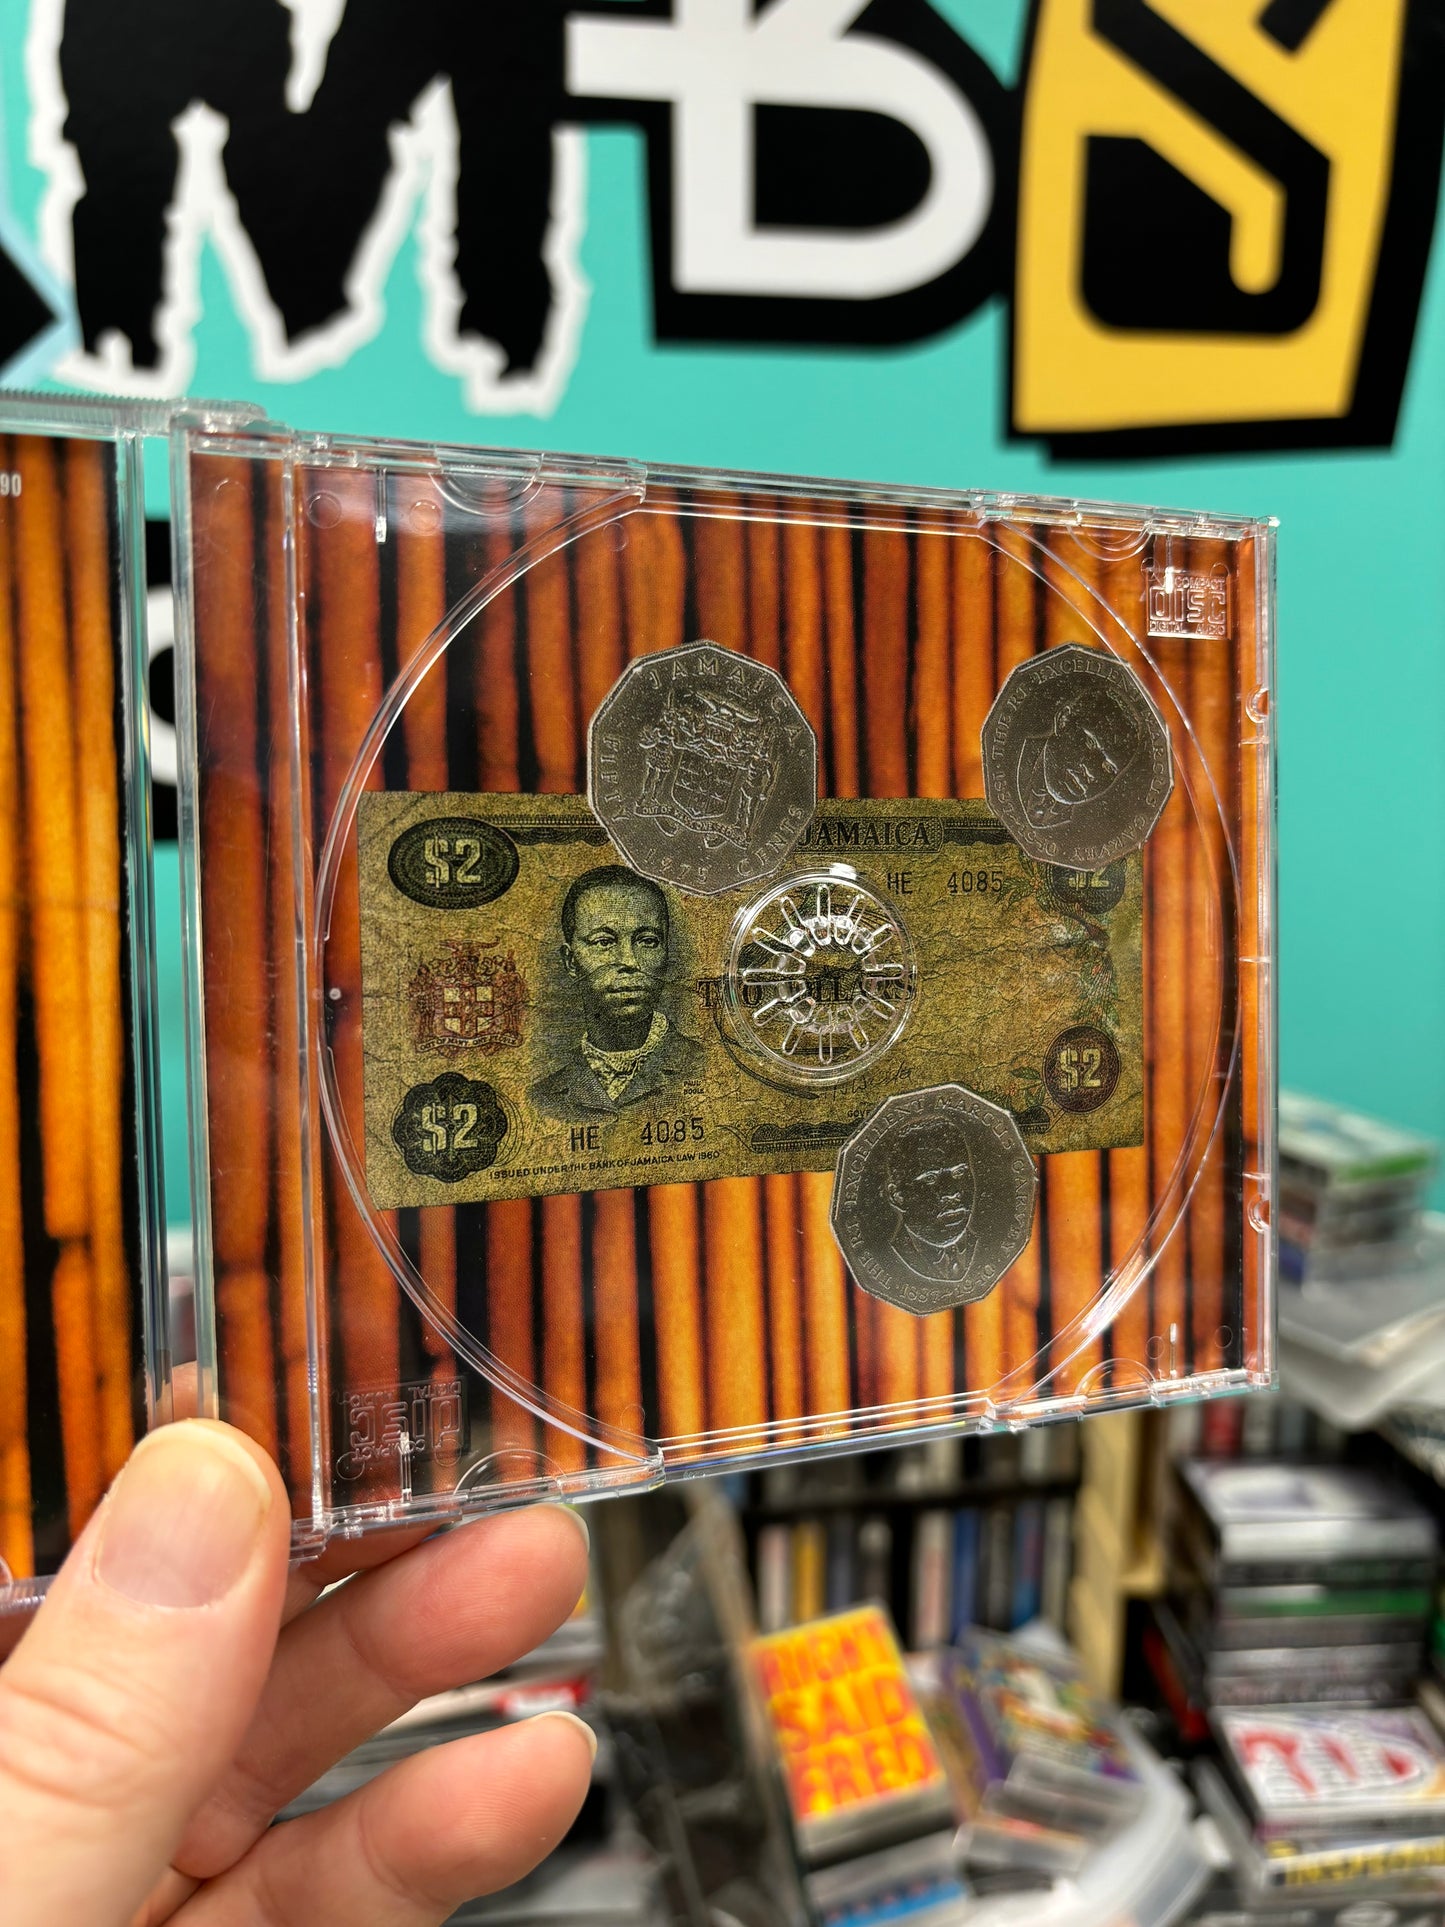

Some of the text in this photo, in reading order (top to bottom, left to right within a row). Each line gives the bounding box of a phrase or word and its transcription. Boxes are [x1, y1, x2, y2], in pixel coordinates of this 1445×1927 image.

[1175, 576, 1225, 590] COMPACT
[1150, 622, 1225, 635] DIGITAL AUDIO
[649, 657, 802, 748] JAMAICA
[736, 804, 804, 877] CENTS
[799, 821, 931, 847] JAMAICA
[423, 832, 482, 889] $2
[887, 870, 1003, 895] HE 4085
[1057, 1048, 1102, 1093] $2
[420, 1101, 480, 1155] $2
[570, 1116, 705, 1152] HE 4085
[489, 1167, 531, 1180] ISSUED
[532, 1164, 568, 1176] UNDER
[569, 1162, 587, 1172] THE
[589, 1160, 616, 1170] BANK
[616, 1158, 630, 1168] OF
[630, 1154, 673, 1167] JAMAICA
[676, 1152, 697, 1161] LAW
[858, 1250, 893, 1290] THE
